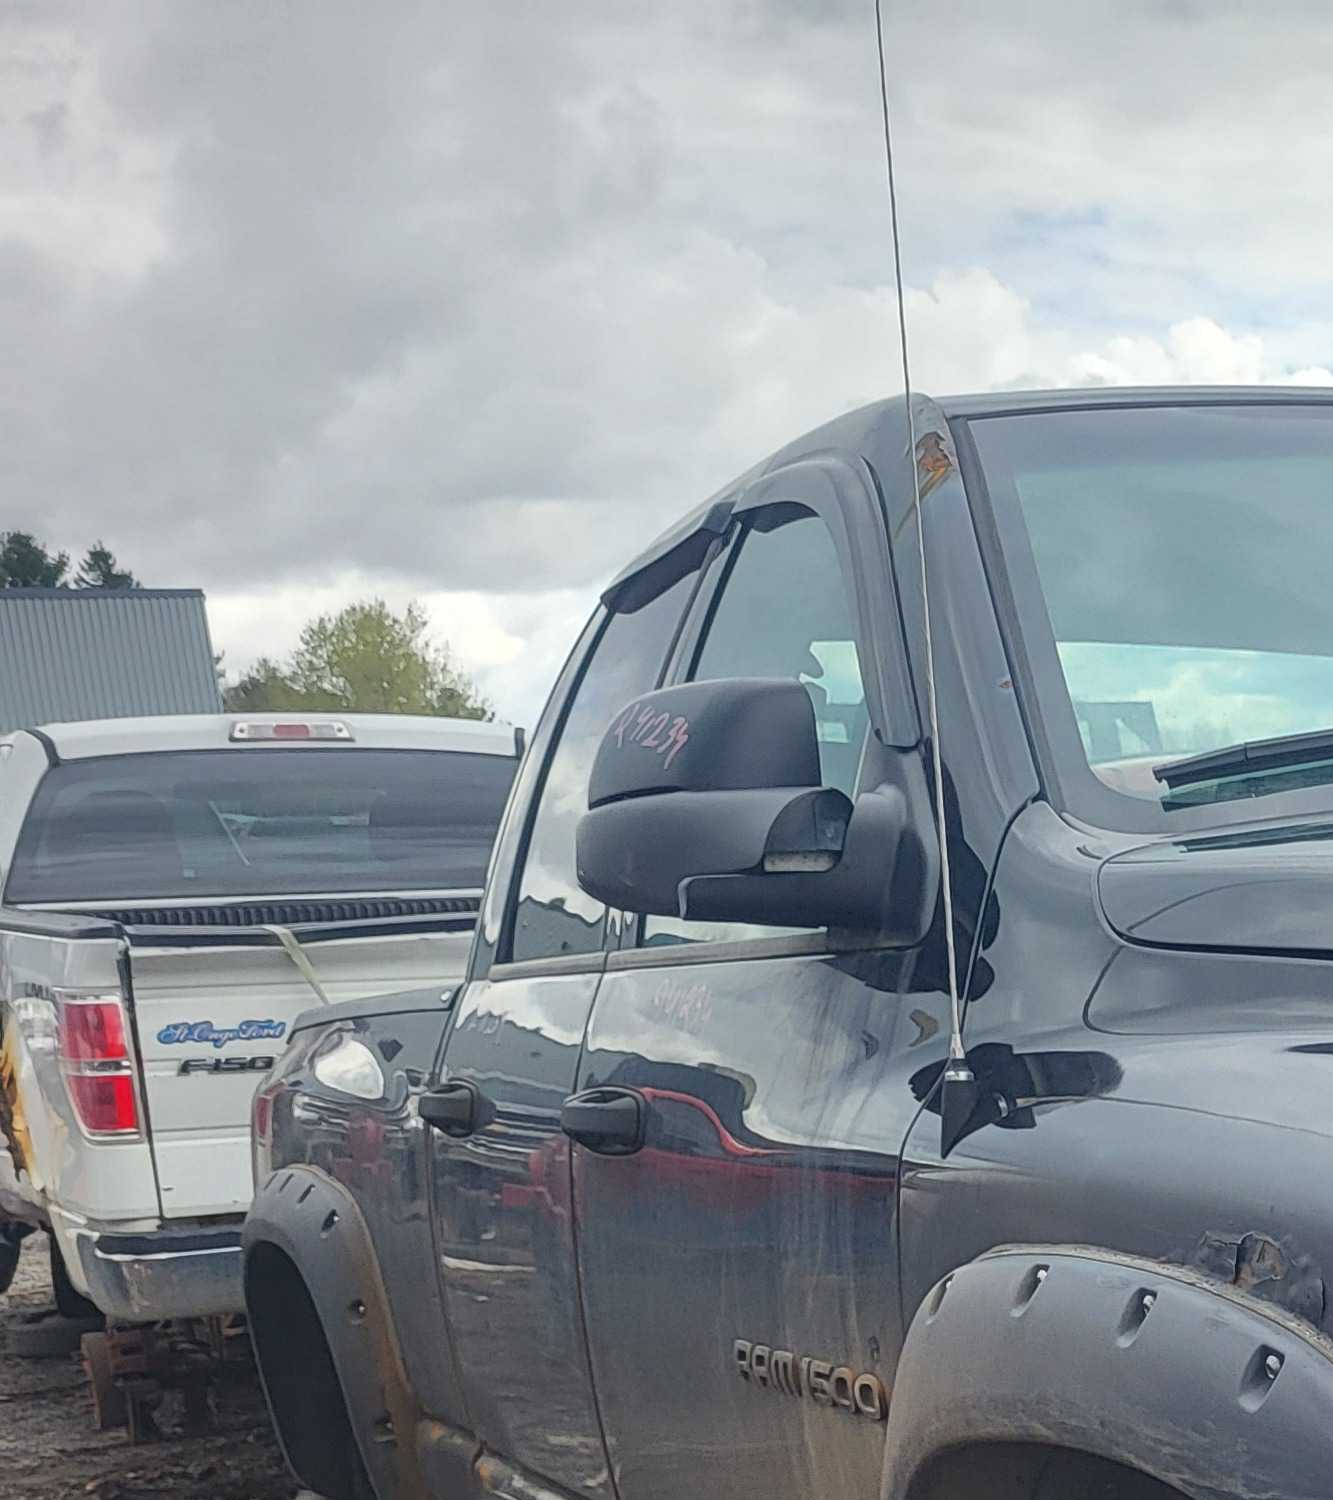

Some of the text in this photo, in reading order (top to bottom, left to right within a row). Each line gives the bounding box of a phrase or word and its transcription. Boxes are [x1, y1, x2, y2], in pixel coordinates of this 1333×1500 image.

[240, 1018, 286, 1041] Ford
[733, 1338, 890, 1420] RAM 1500
